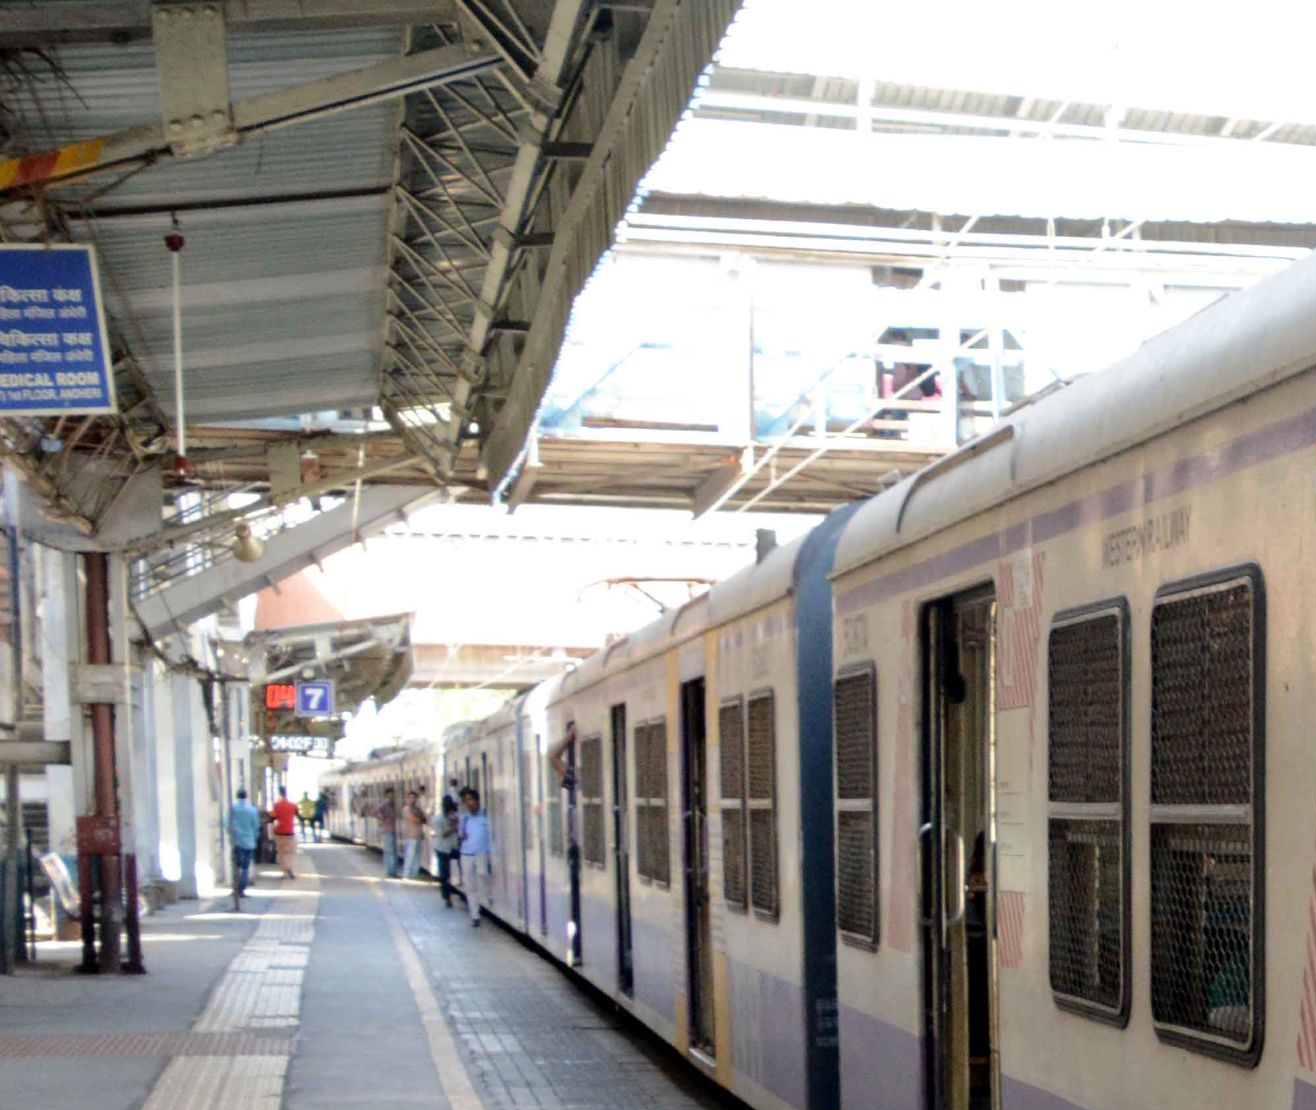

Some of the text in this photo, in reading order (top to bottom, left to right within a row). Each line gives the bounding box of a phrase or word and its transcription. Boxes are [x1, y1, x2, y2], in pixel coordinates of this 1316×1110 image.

[0, 372, 100, 387] EDICAL ROOM
[1102, 503, 1192, 571] WESTERN RAILWAY
[304, 687, 324, 710] 7
